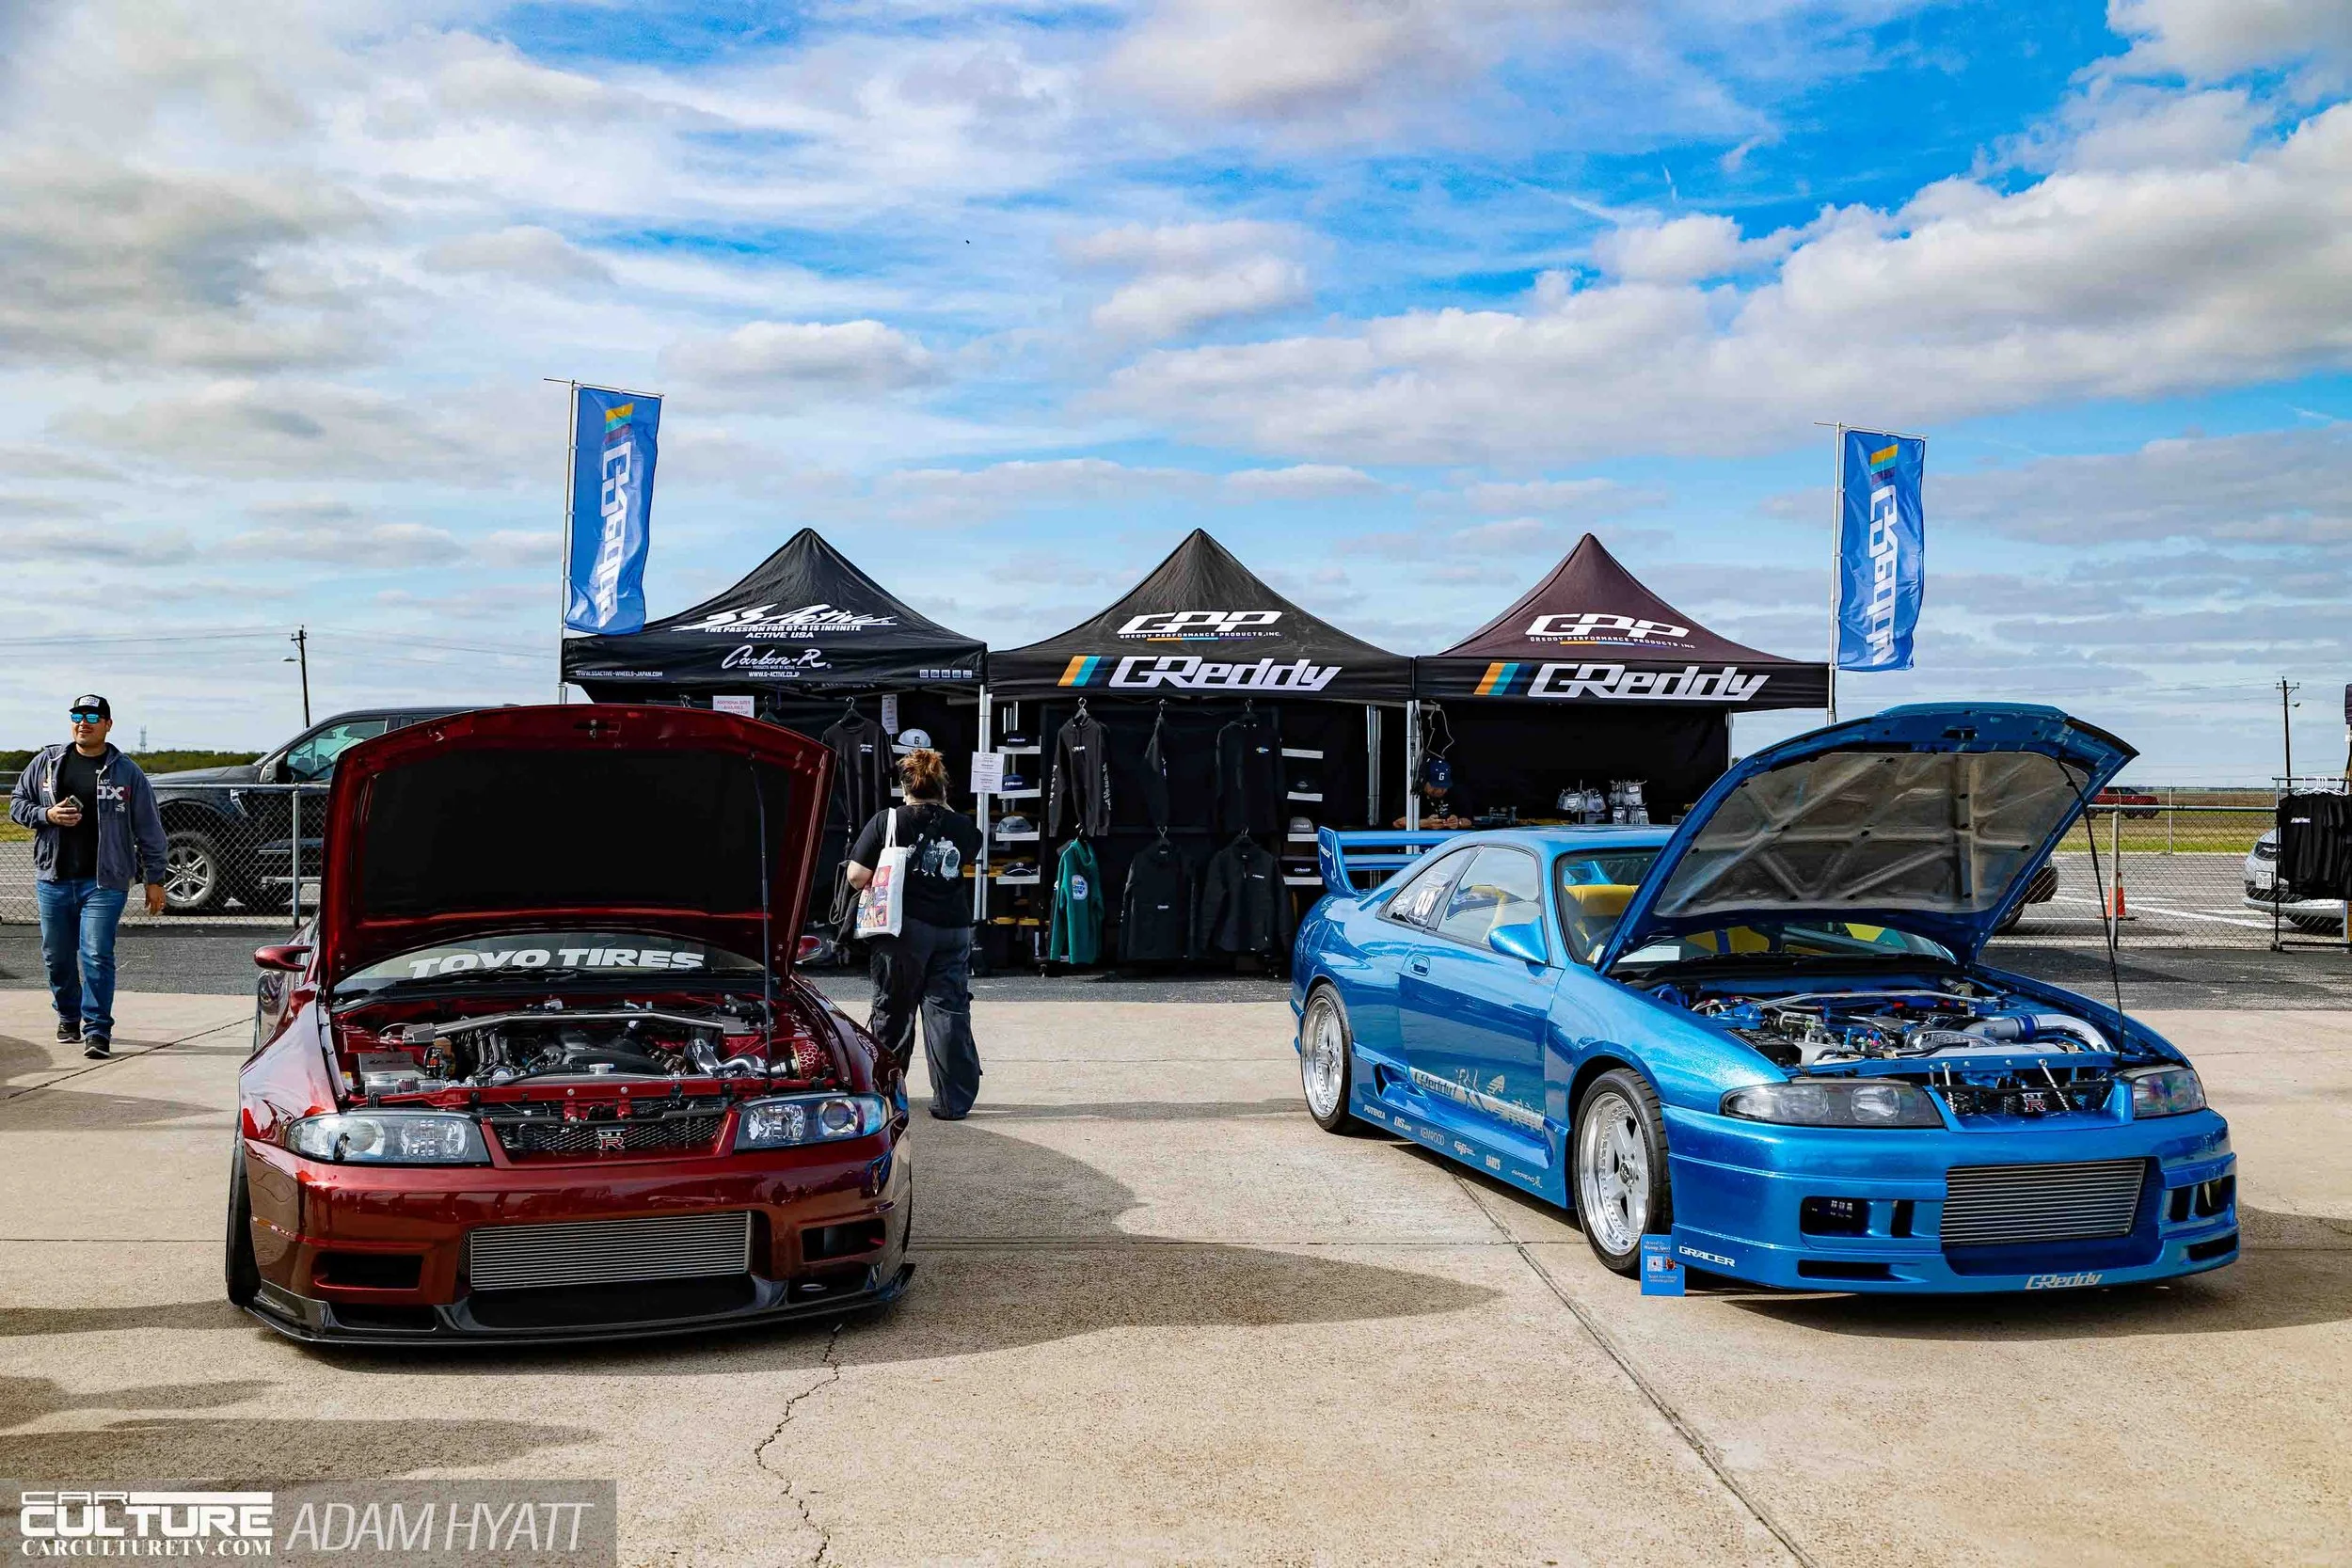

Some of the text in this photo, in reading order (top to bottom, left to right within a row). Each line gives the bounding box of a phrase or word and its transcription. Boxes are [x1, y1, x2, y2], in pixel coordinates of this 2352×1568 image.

[1117, 610, 1283, 634] GPP
[1525, 613, 1690, 638] GPP
[1633, 638, 1678, 647] PRODUCTS
[722, 644, 827, 669] Carbon-R
[1108, 656, 1343, 691] GReddy
[1528, 663, 1771, 701] GReddy
[1438, 772, 1445, 781] G
[557, 948, 705, 969] TIRES
[2023, 1099, 2046, 1112] R
[598, 1136, 626, 1150] R
[1420, 1126, 1445, 1146] KENWOOD
[1678, 1245, 1736, 1267] GRACER
[2024, 1272, 2103, 1291] GReddy
